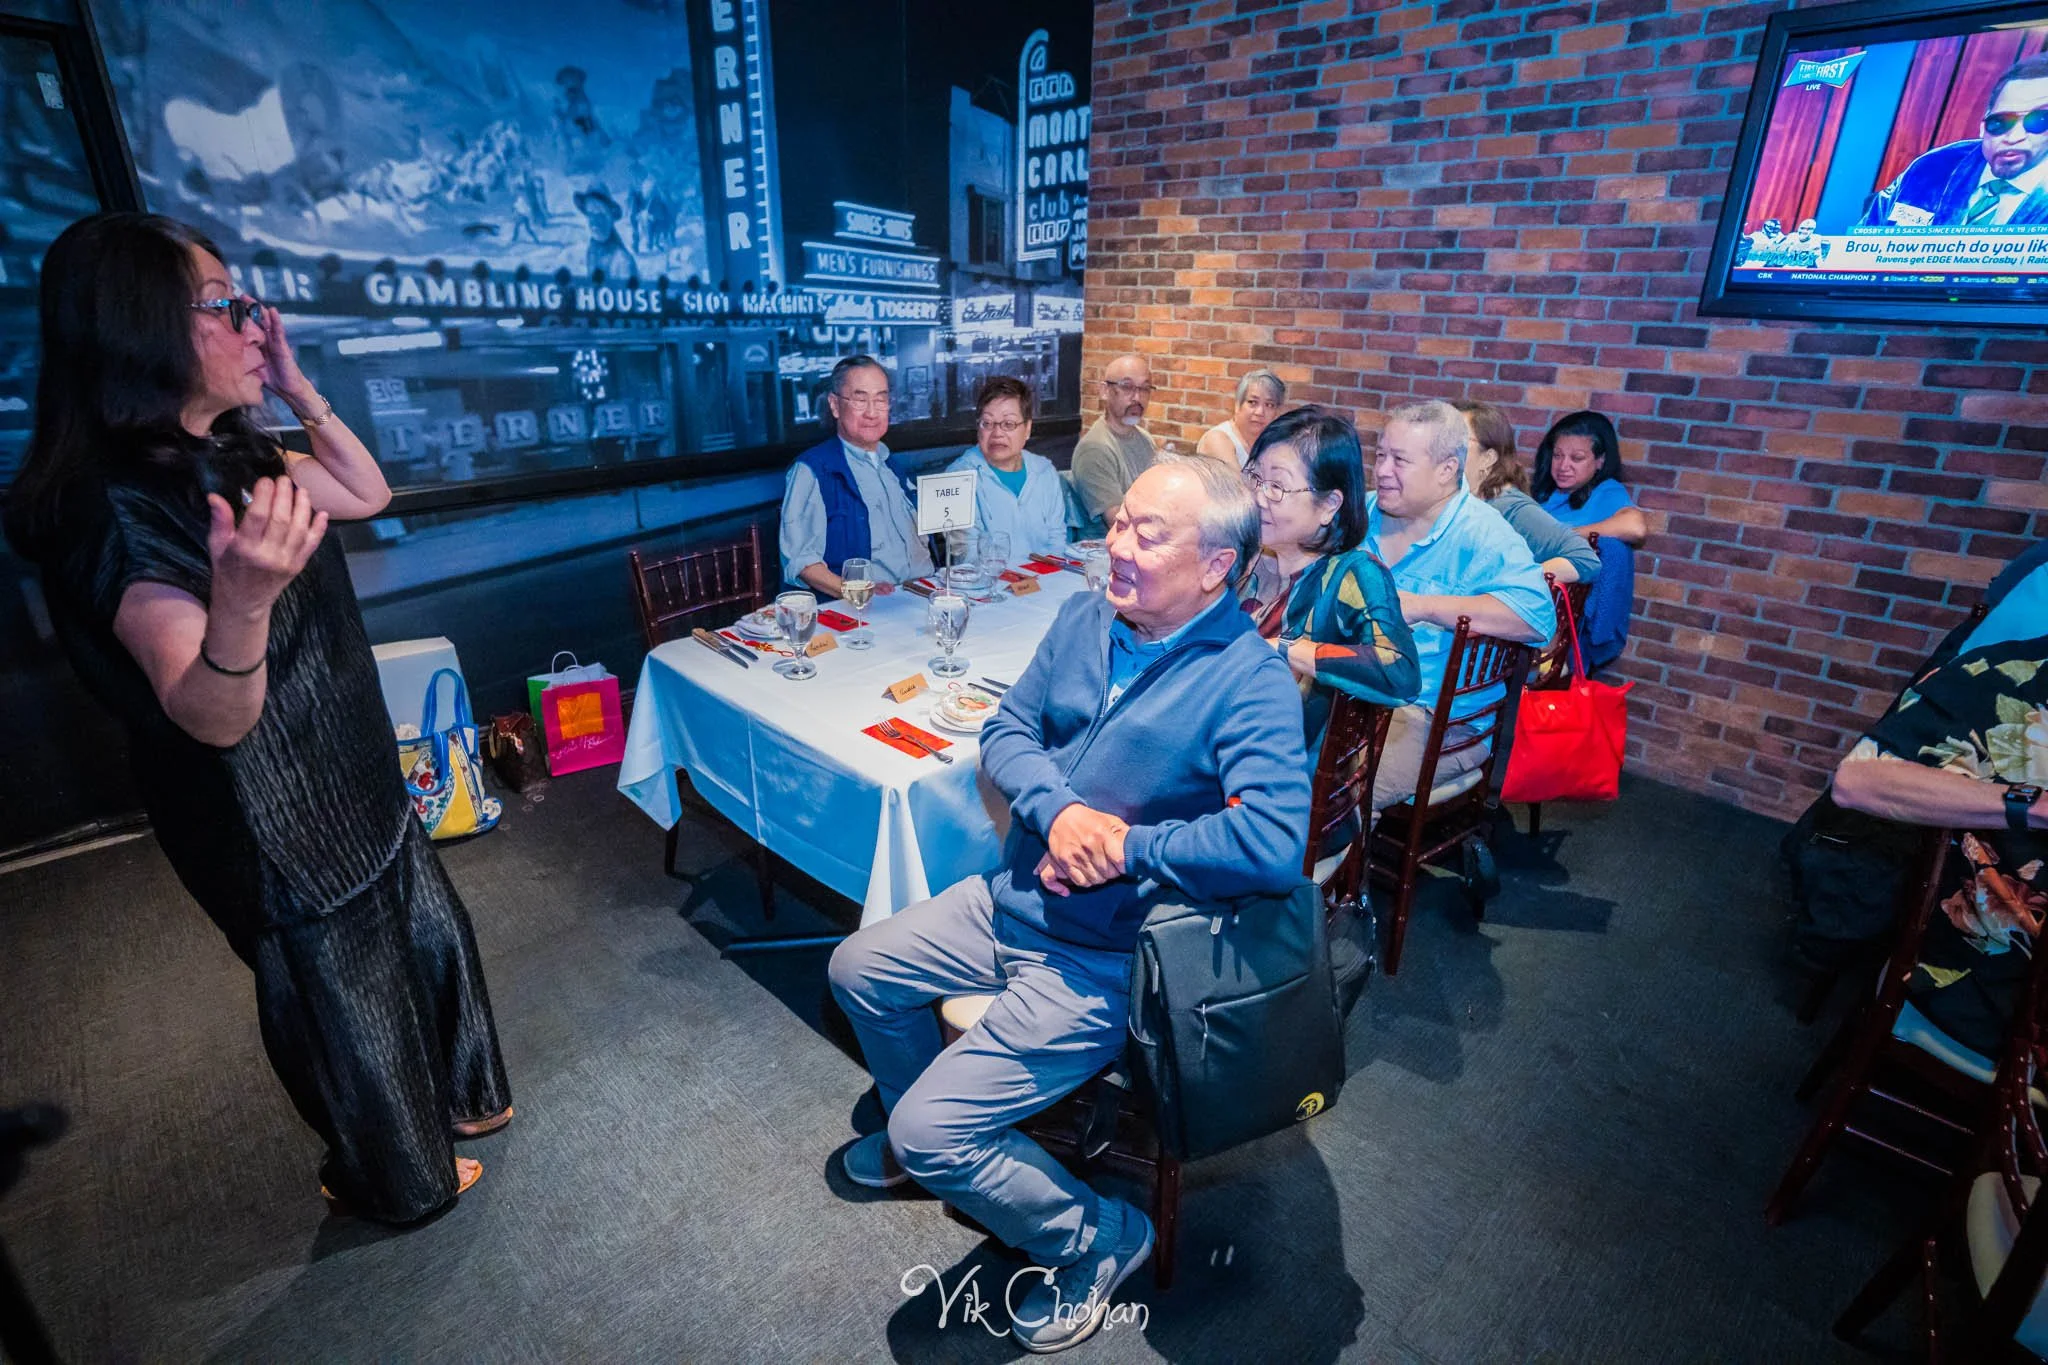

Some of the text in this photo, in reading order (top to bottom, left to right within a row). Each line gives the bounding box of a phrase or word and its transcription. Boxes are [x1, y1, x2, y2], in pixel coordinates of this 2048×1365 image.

[1815, 61, 1849, 79] FIRST
[1805, 83, 1822, 91] LIVE
[1028, 105, 1091, 149] MONT
[1028, 148, 1089, 189] CARL
[1029, 190, 1070, 220] club
[1853, 227, 1883, 235] CROSBY
[1951, 226, 1988, 234] ENTERING
[1845, 240, 1883, 254] Brou,
[1886, 240, 1919, 253] how
[1921, 239, 1966, 253] much
[1969, 239, 1989, 253] do
[1993, 242, 2025, 256] you
[817, 252, 936, 281] MEN'S FURNISHINGS
[1875, 255, 1909, 264] Ravens
[1909, 256, 1925, 265] get
[1926, 255, 1952, 264] EDGE
[1953, 255, 1980, 264] Maxx
[1981, 255, 2018, 265] Crosby
[368, 271, 563, 310] GAMBLING
[576, 286, 662, 313] HOUSE
[877, 299, 939, 319] TOGGERY
[387, 402, 666, 455] TERNER
[935, 487, 960, 498] TABLE
[943, 506, 950, 518] 5
